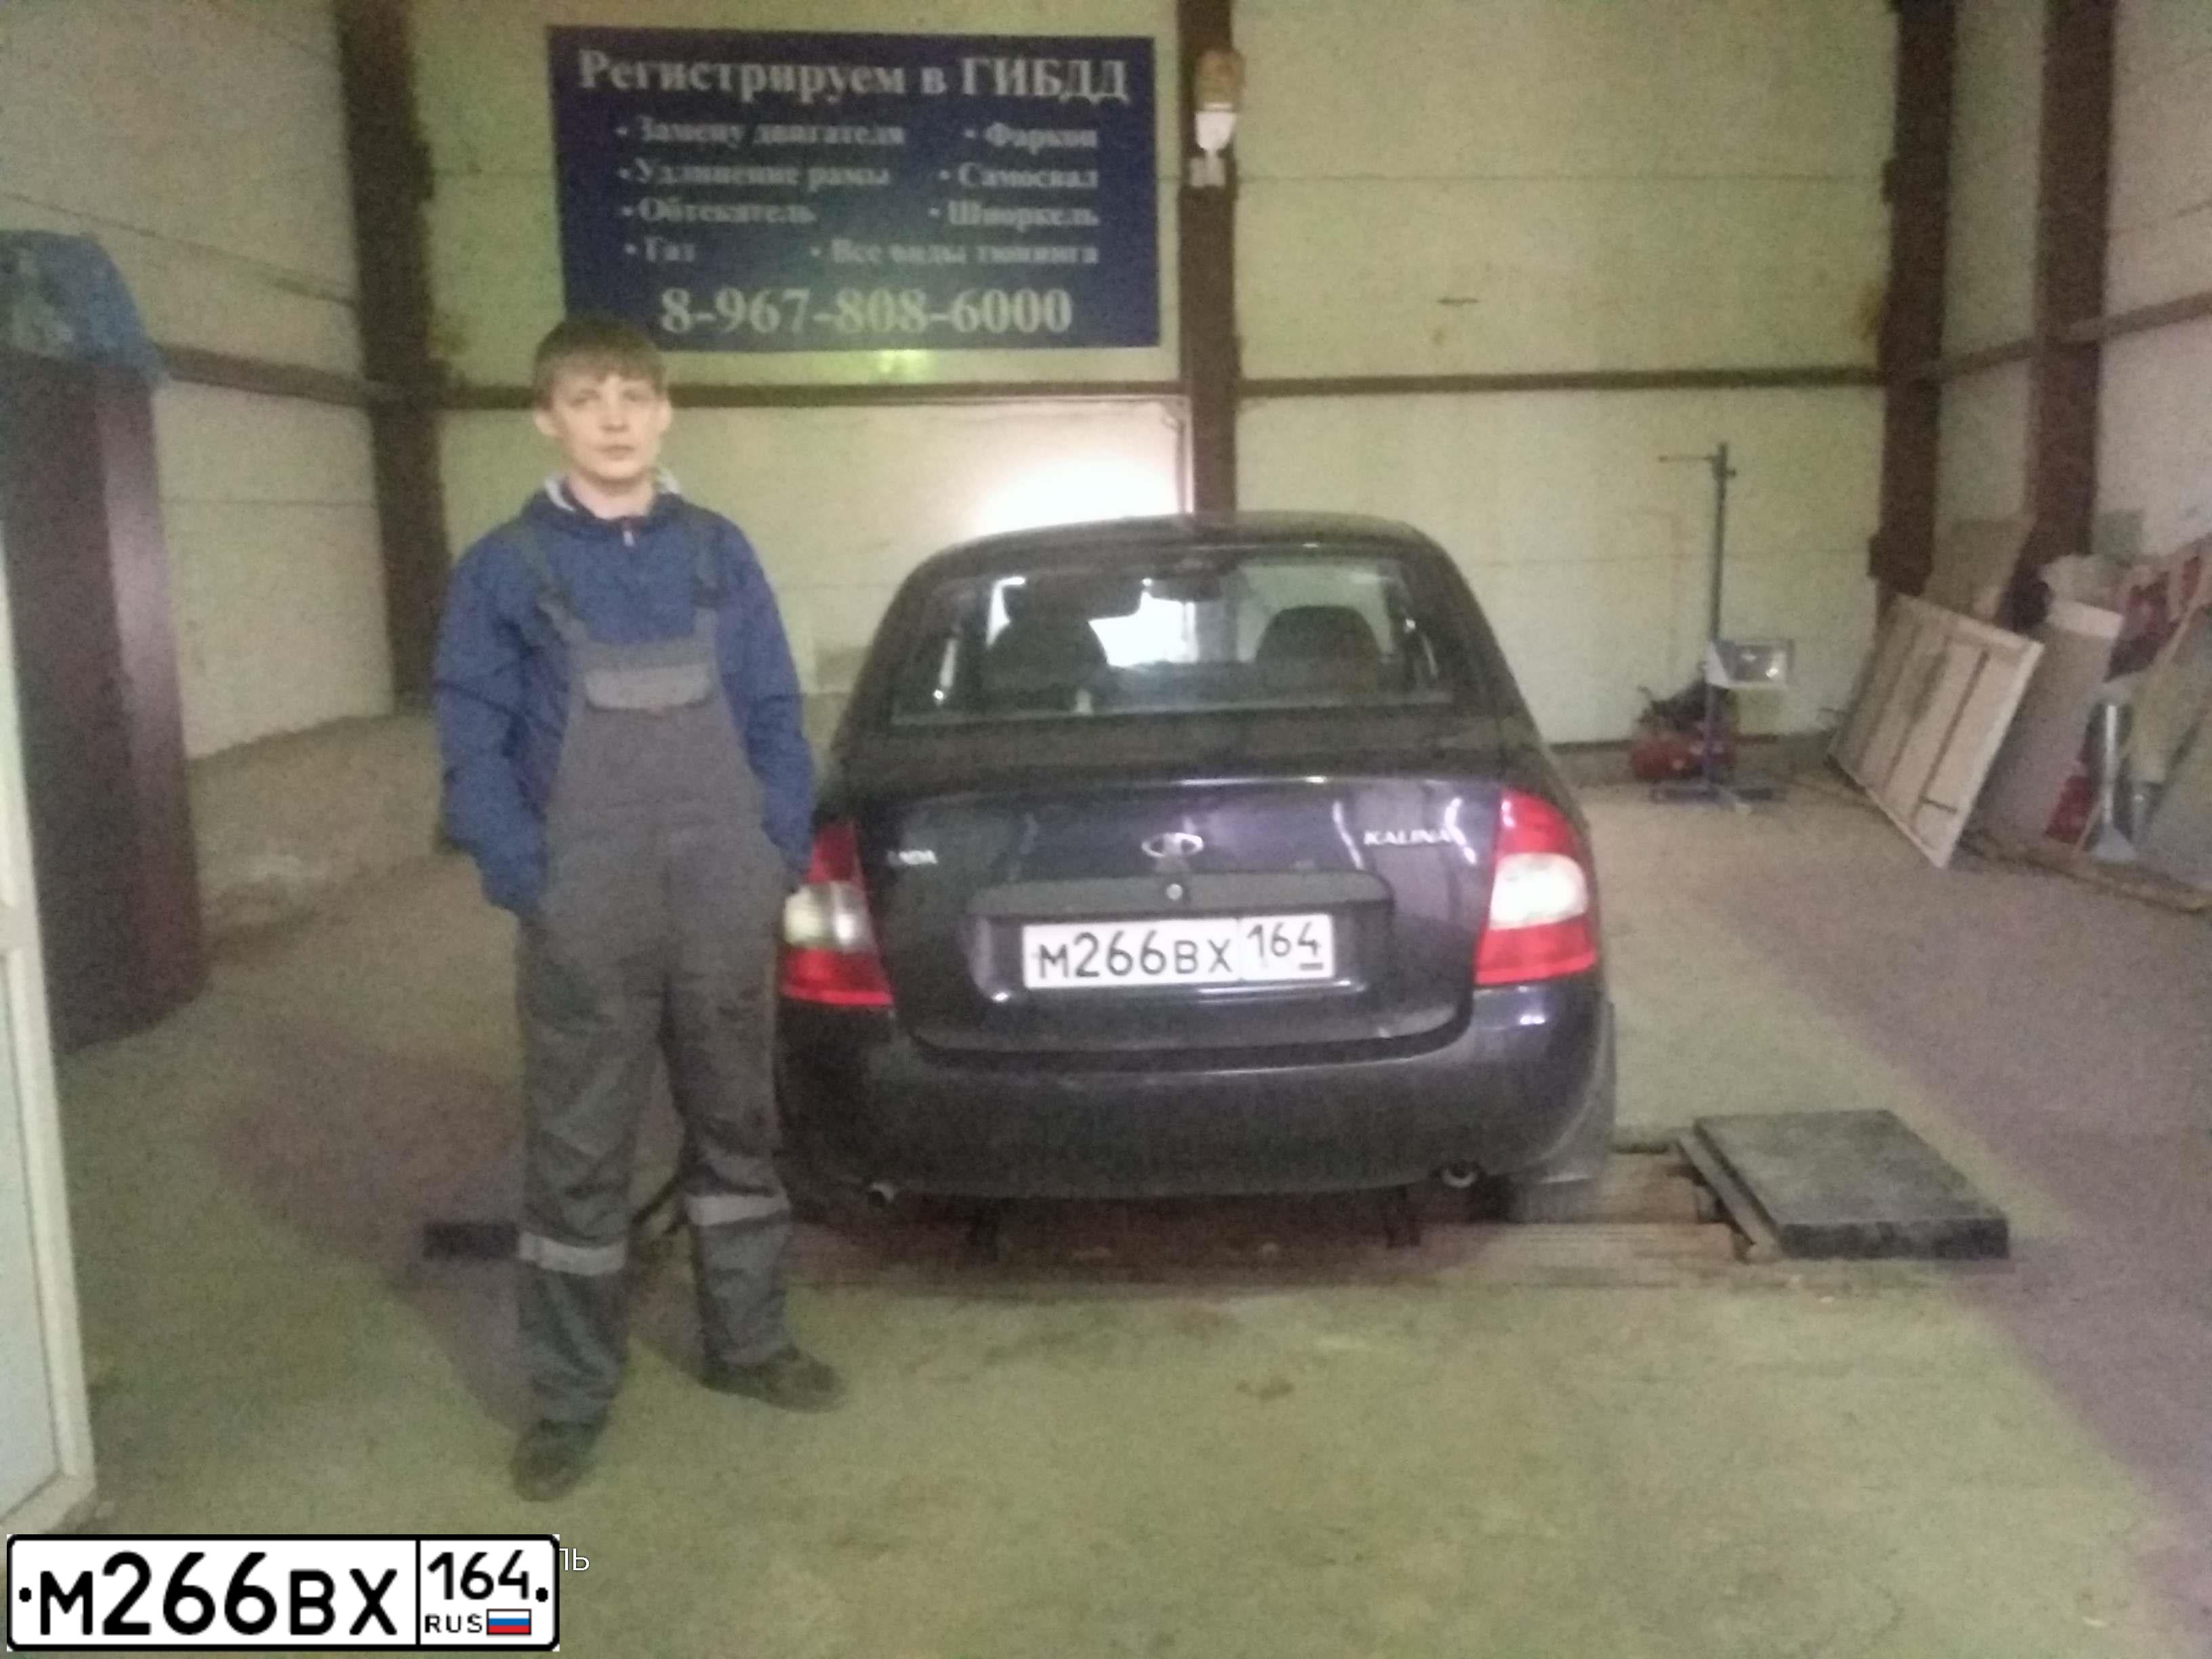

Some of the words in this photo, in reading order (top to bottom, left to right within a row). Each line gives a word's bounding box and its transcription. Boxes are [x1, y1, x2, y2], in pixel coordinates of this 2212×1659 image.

[578, 49, 905, 104] Регистрируем
[920, 66, 947, 94] в
[961, 56, 1130, 104] ГИБДД
[660, 286, 1073, 335] 8-967-808-6000
[1246, 922, 1320, 968] 164
